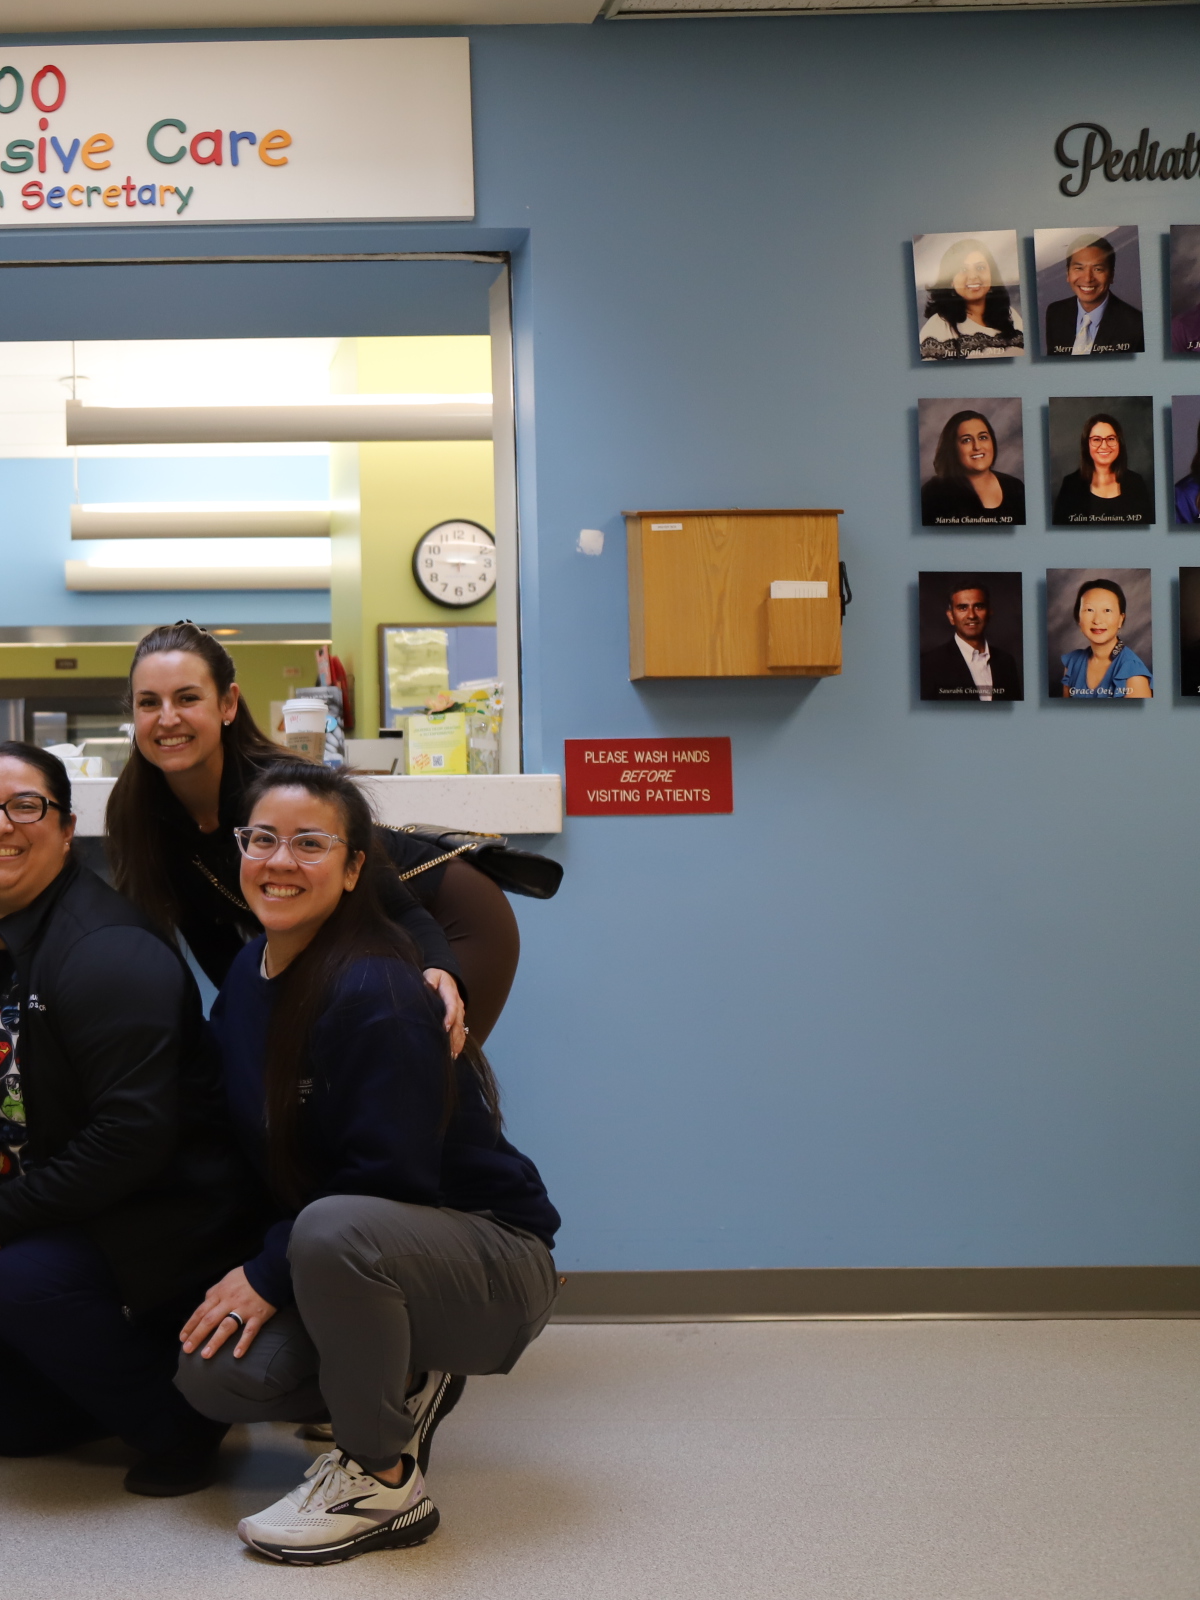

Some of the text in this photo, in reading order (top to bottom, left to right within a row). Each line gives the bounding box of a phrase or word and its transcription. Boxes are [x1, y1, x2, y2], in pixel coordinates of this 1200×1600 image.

[146, 118, 292, 167] Care
[1054, 122, 1200, 197] Pediat
[21, 176, 194, 214] Secretary
[1116, 343, 1130, 351] MD
[1068, 513, 1088, 522] Talin
[441, 534, 448, 543] 11
[453, 530, 465, 540] 12
[428, 545, 441, 555] 10
[479, 545, 488, 555] 2
[425, 558, 433, 568] 9
[483, 558, 492, 568] 3
[430, 572, 438, 582] 8
[479, 573, 486, 582] 4
[441, 583, 448, 592] 7
[454, 586, 463, 596] 6
[468, 582, 476, 592] 5
[1069, 687, 1094, 696] Grace
[1115, 687, 1134, 695] MD
[585, 750, 710, 763] PLEASE WASH HANDS
[620, 770, 676, 782] BEFORE
[587, 789, 711, 802] VISITING PATIENTS
[332, 1502, 349, 1512] BROOKS
